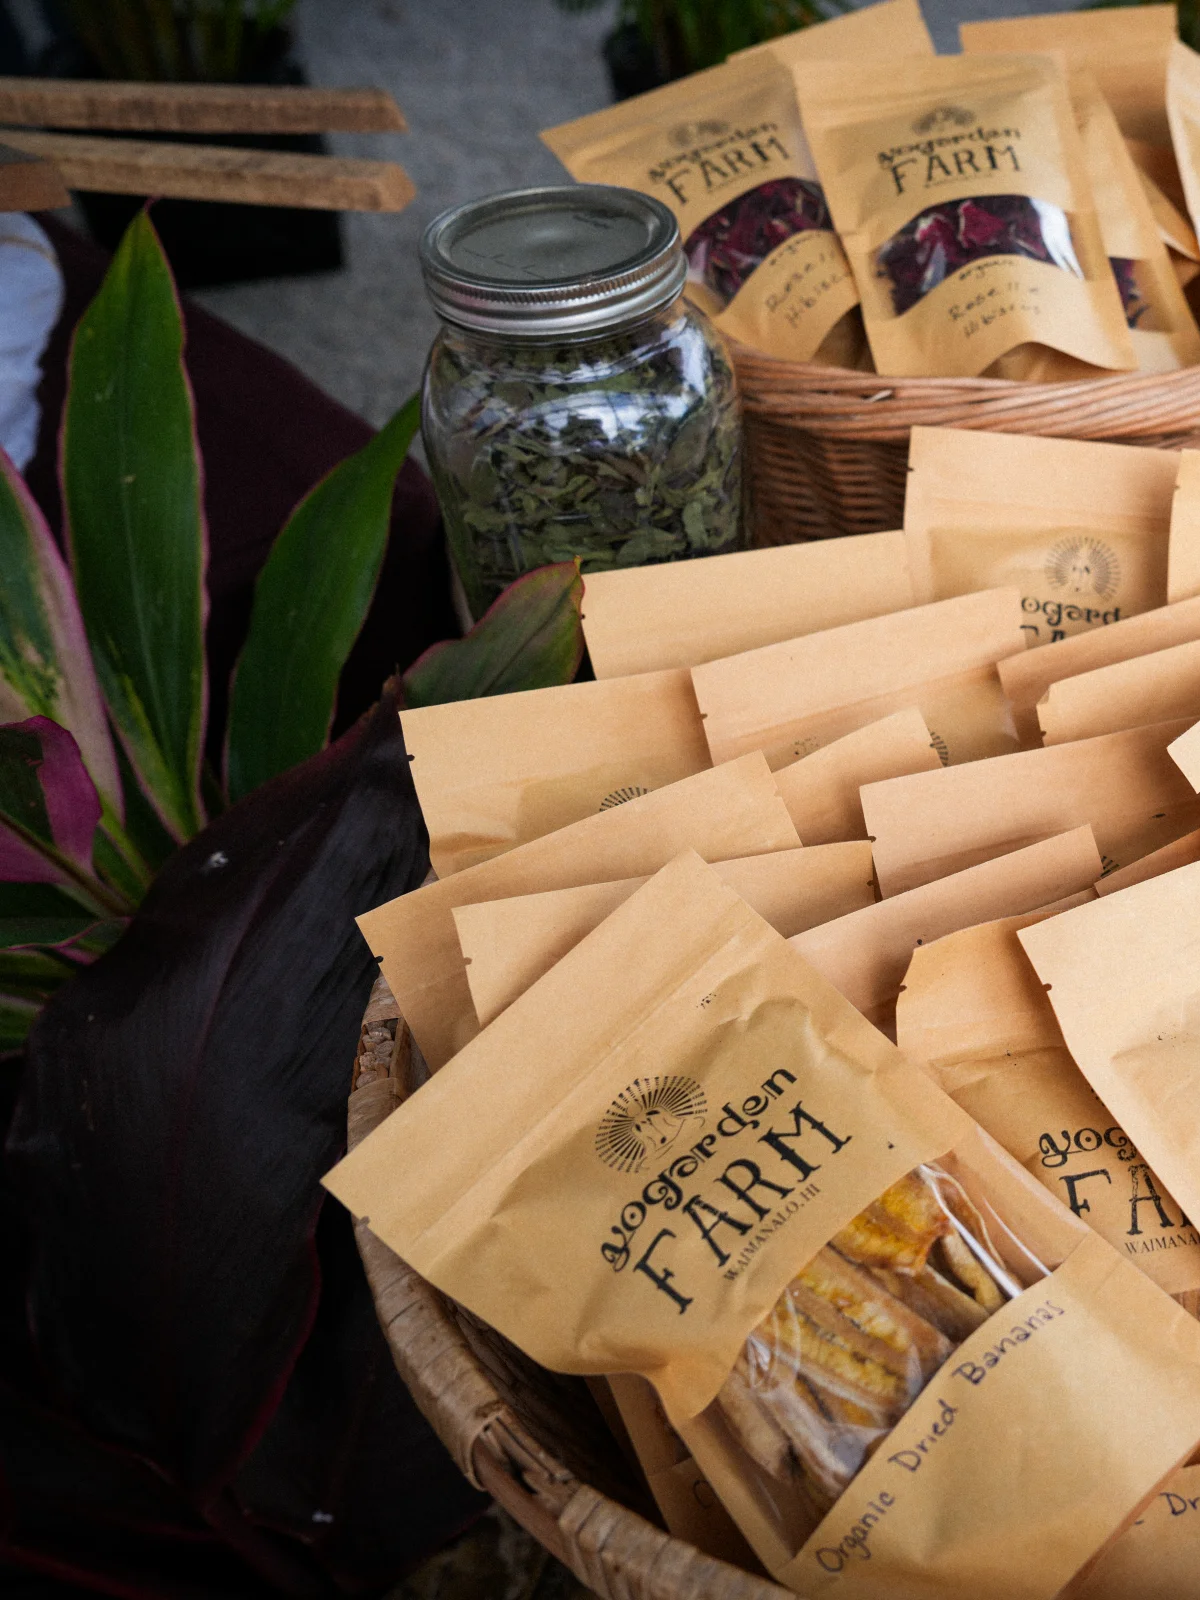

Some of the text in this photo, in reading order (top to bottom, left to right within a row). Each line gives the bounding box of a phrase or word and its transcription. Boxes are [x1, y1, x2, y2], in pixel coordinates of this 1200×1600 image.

[665, 135, 791, 205] FARM
[890, 145, 1022, 196] FARM
[1020, 597, 1121, 627] ogard
[601, 1067, 798, 1272] yogarden
[632, 1100, 853, 1316] FARM
[815, 1300, 1066, 1574] Organic Dried Bananas
